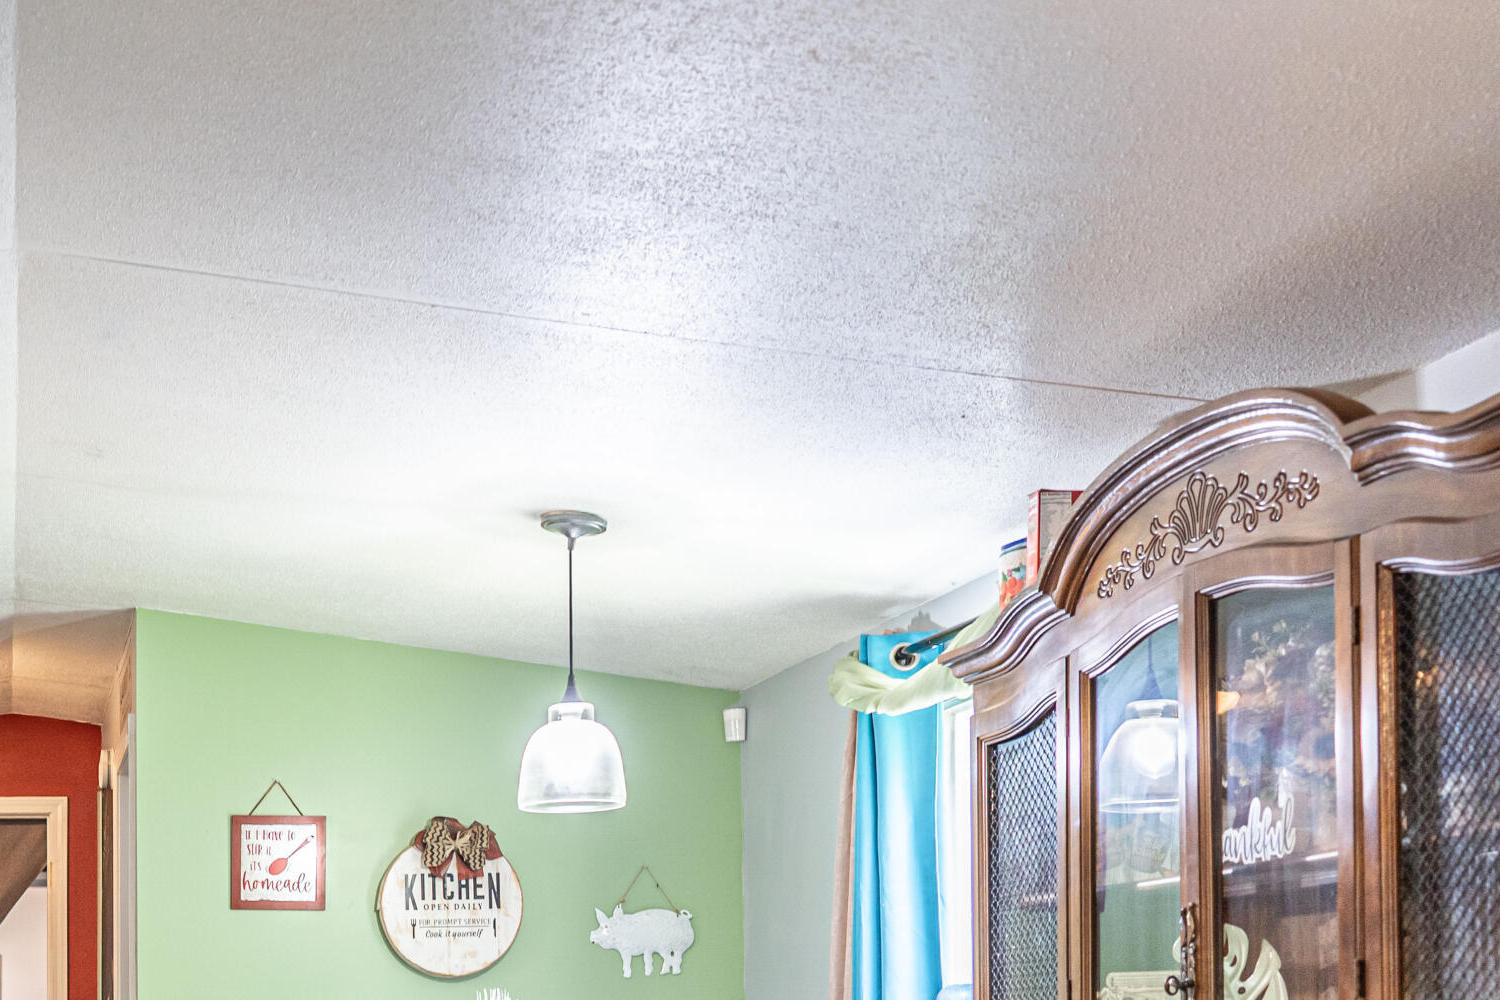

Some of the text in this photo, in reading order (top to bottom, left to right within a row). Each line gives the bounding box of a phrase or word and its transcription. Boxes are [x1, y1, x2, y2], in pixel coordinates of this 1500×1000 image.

[1222, 792, 1296, 864] ankful
[404, 872, 501, 911] KITCHEN
[423, 902, 483, 911] OPEN DAILY
[433, 918, 462, 926] PROMPT
[463, 917, 492, 926] SERVICE
[425, 928, 484, 940] Cook it yourself
